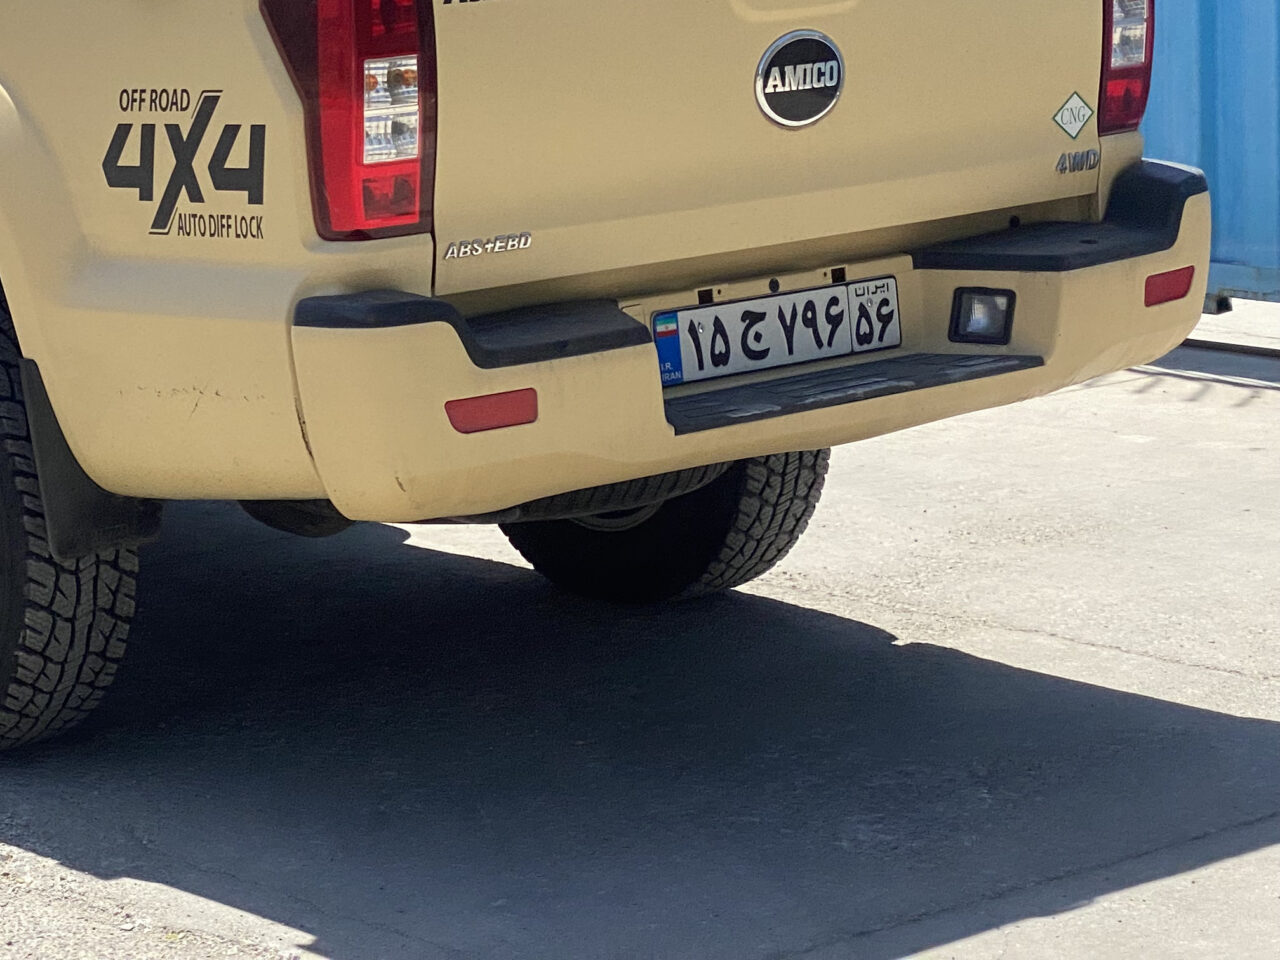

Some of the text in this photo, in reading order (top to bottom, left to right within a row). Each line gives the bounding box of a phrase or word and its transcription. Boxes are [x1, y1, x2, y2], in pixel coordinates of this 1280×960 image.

[764, 60, 839, 94] AMICO
[119, 88, 191, 113] OFF ROAD
[1060, 105, 1086, 126] CNG
[1055, 149, 1099, 174] 4WD
[177, 213, 264, 240] AUTO DIFF LOCK
[443, 231, 532, 260] ABS+EBD
[854, 281, 890, 298] ایران
[661, 371, 682, 382] IRAN
